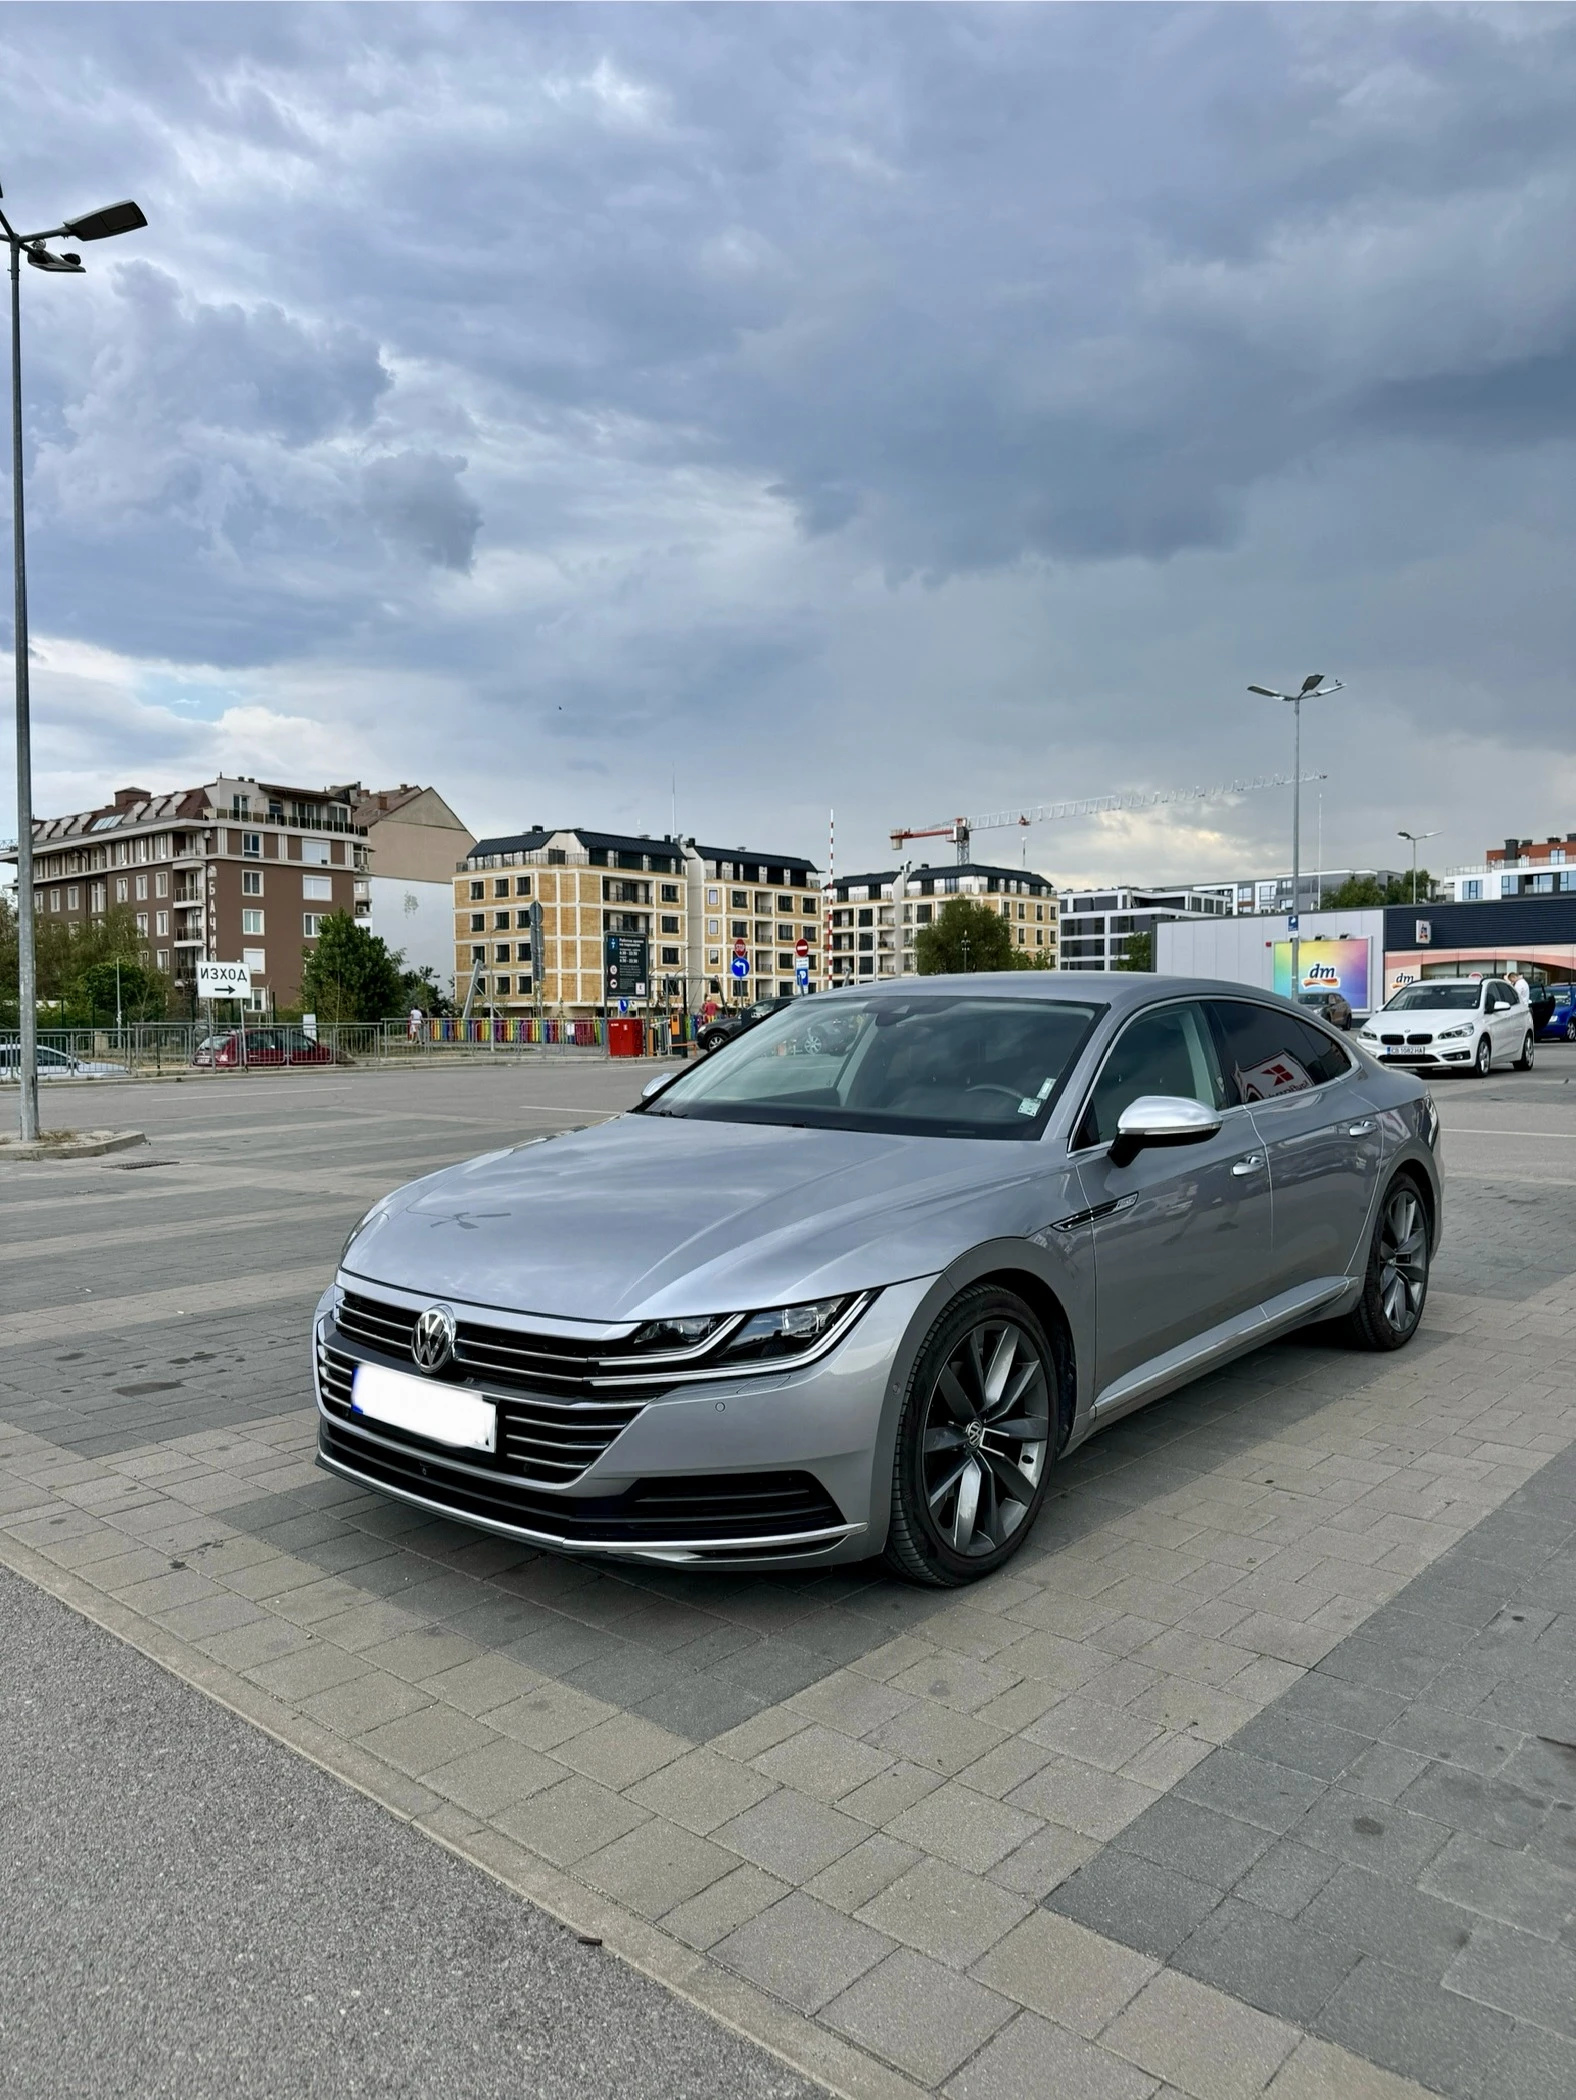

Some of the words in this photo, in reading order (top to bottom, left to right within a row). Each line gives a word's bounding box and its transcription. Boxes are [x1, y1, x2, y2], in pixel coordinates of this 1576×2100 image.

[200, 967, 247, 982] ИЗХОД
[1309, 964, 1335, 979] dm
[1396, 973, 1414, 983] dm
